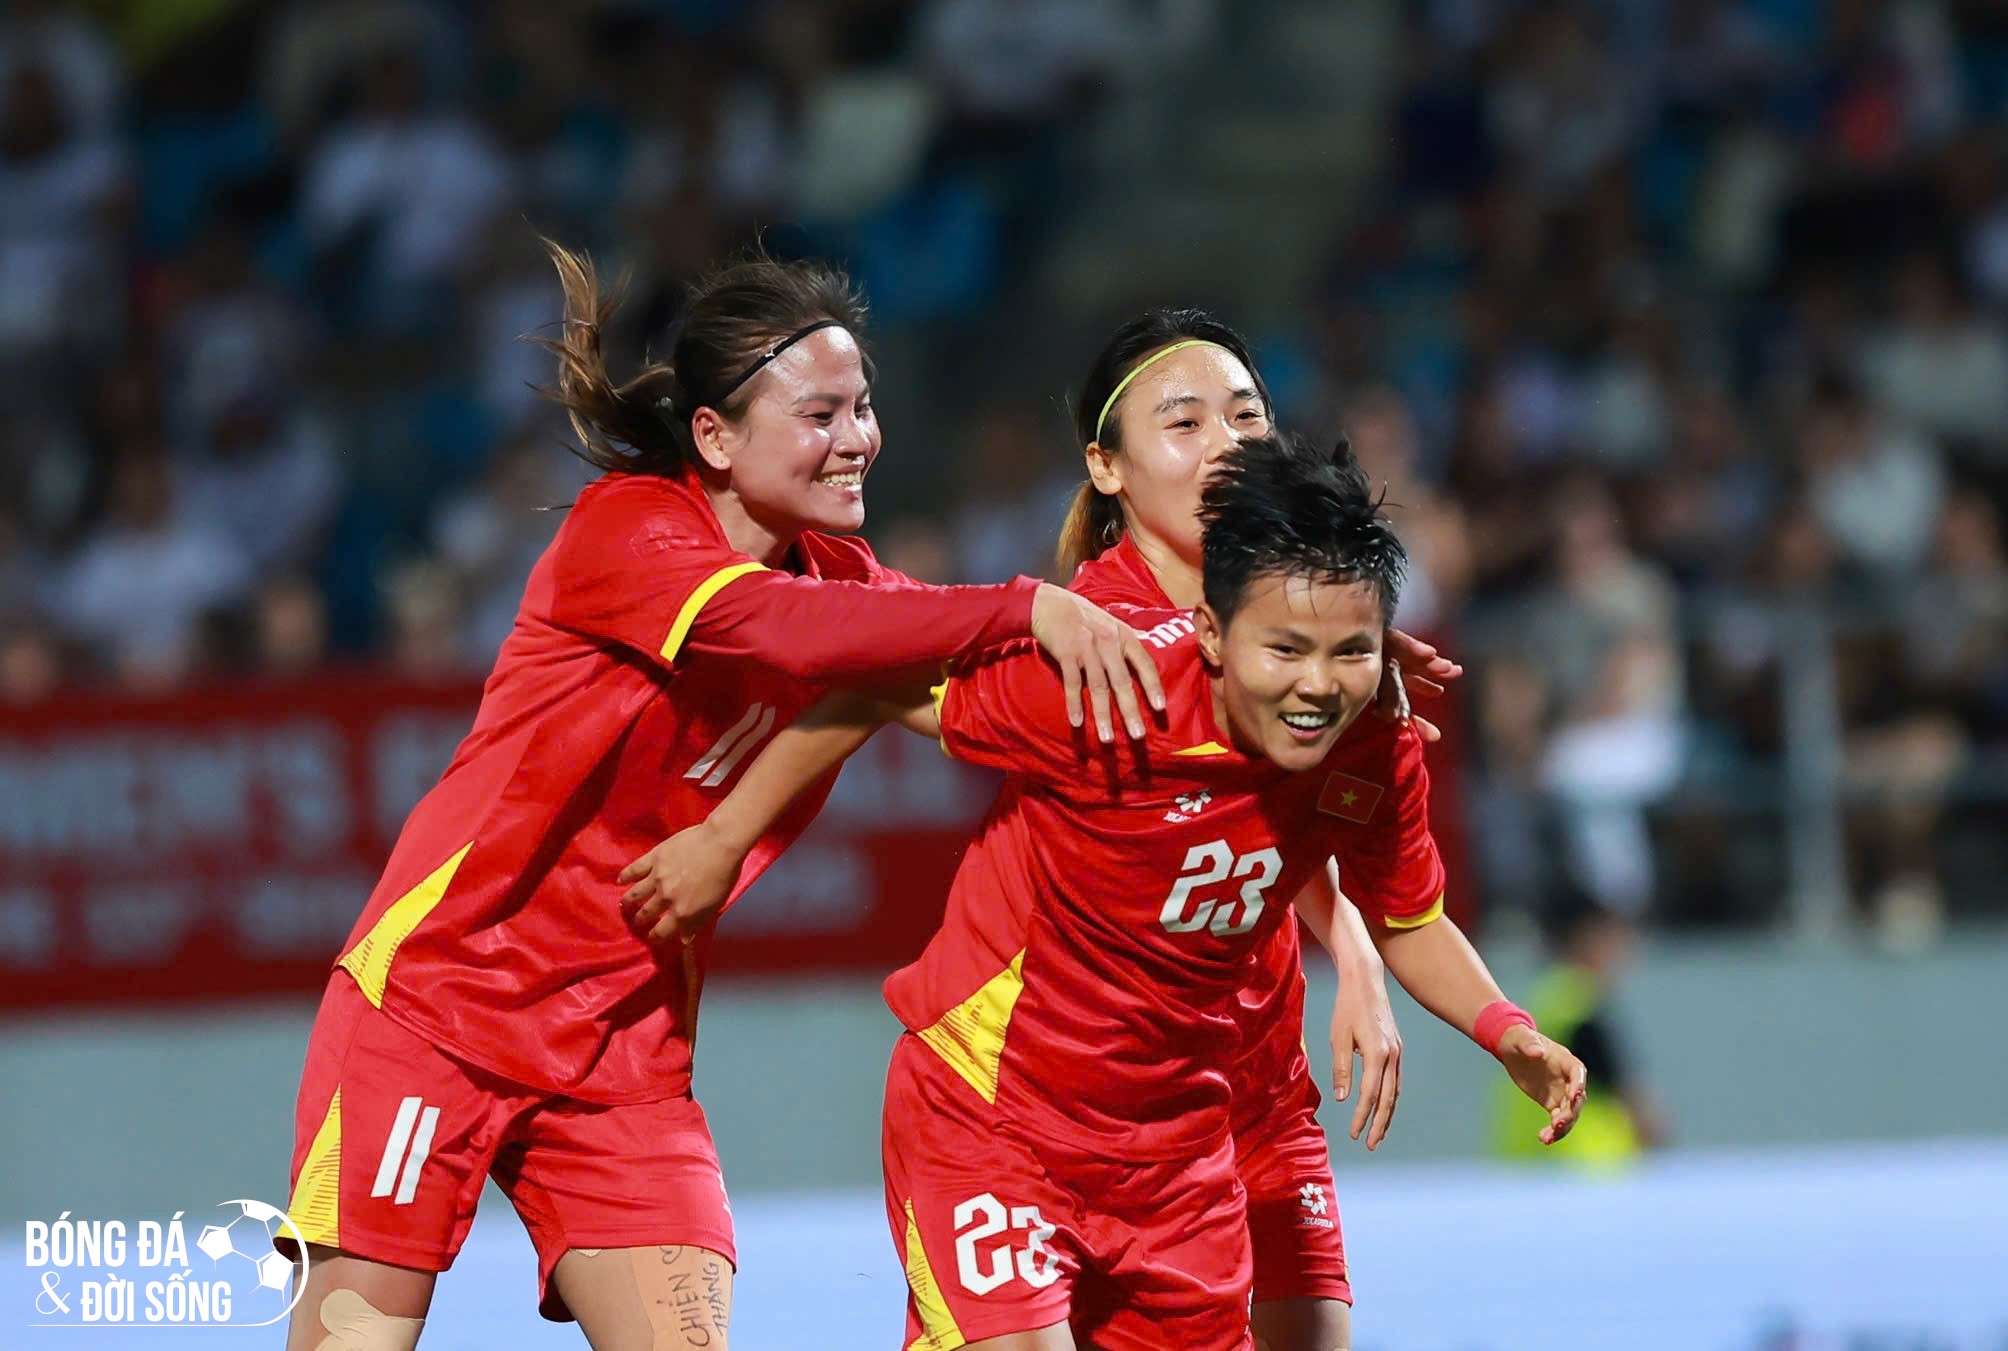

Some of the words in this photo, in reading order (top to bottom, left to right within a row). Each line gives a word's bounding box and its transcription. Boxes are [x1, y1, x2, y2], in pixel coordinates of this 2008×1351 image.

[682, 702, 776, 787] 11
[1159, 839, 1283, 937] 23
[370, 1096, 441, 1205] 11
[954, 1192, 1064, 1296] 23
